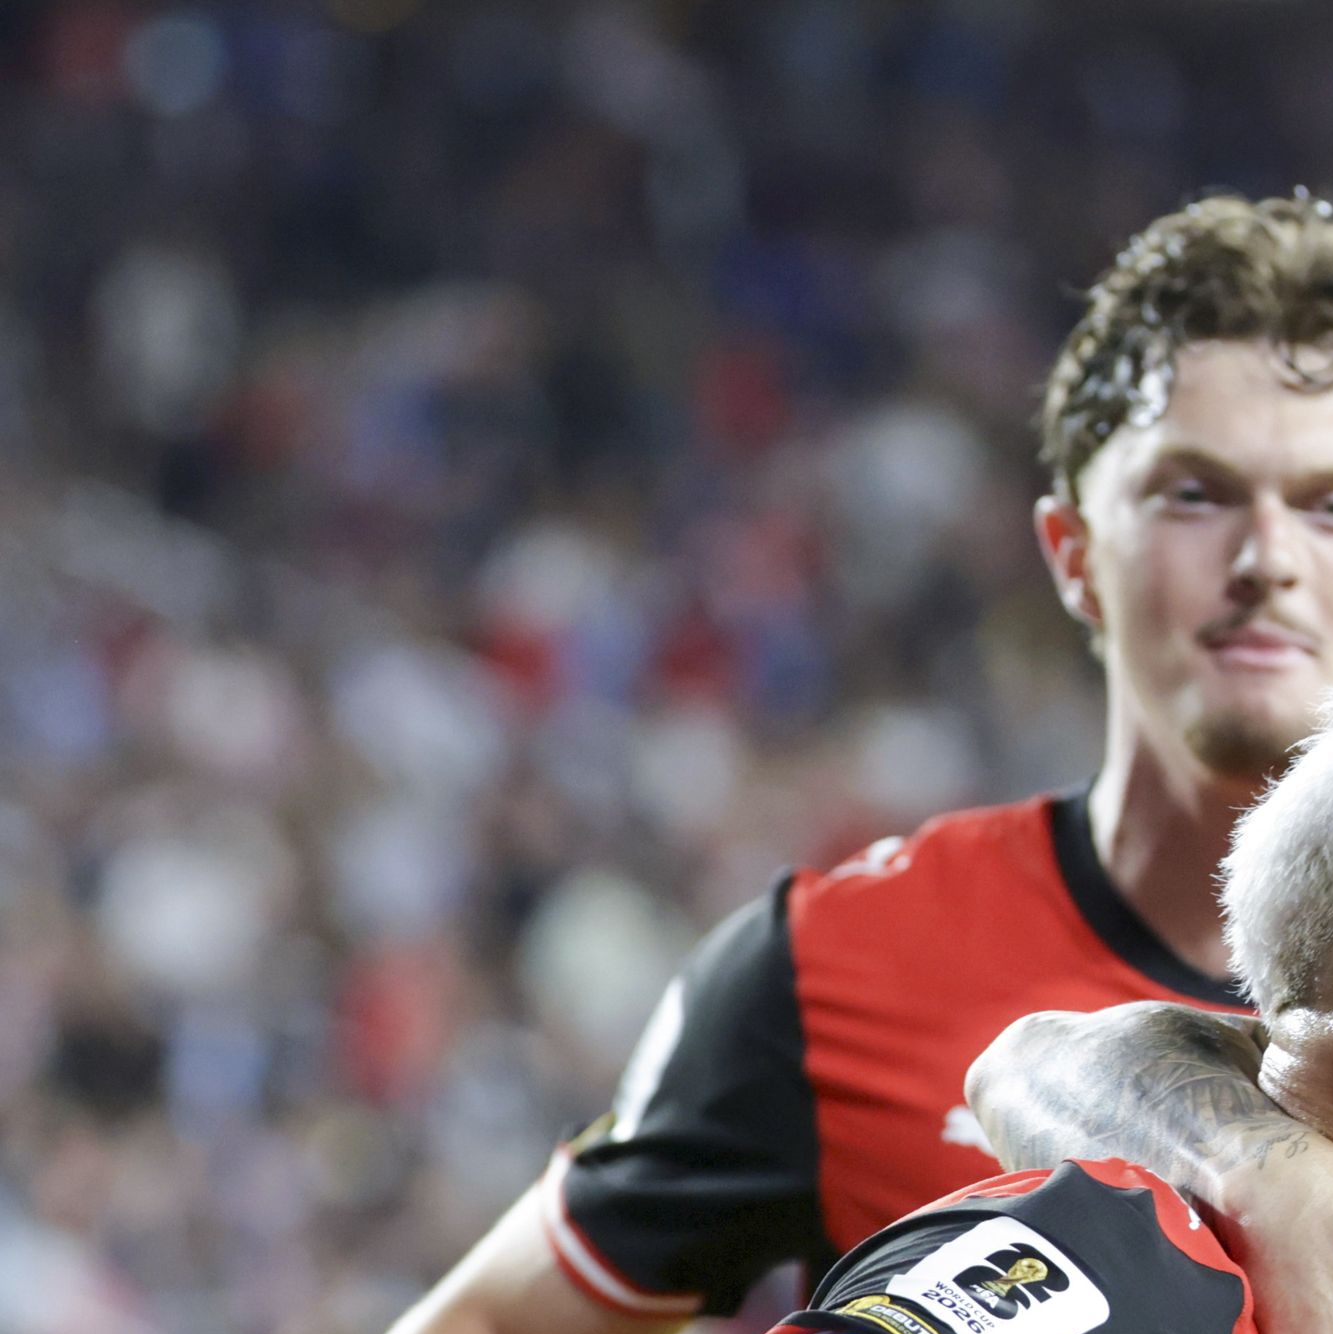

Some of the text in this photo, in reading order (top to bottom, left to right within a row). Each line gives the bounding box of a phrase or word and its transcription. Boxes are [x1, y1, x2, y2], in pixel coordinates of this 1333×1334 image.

[921, 1289, 986, 1334] 2026
[935, 1281, 996, 1329] WORLD CUP
